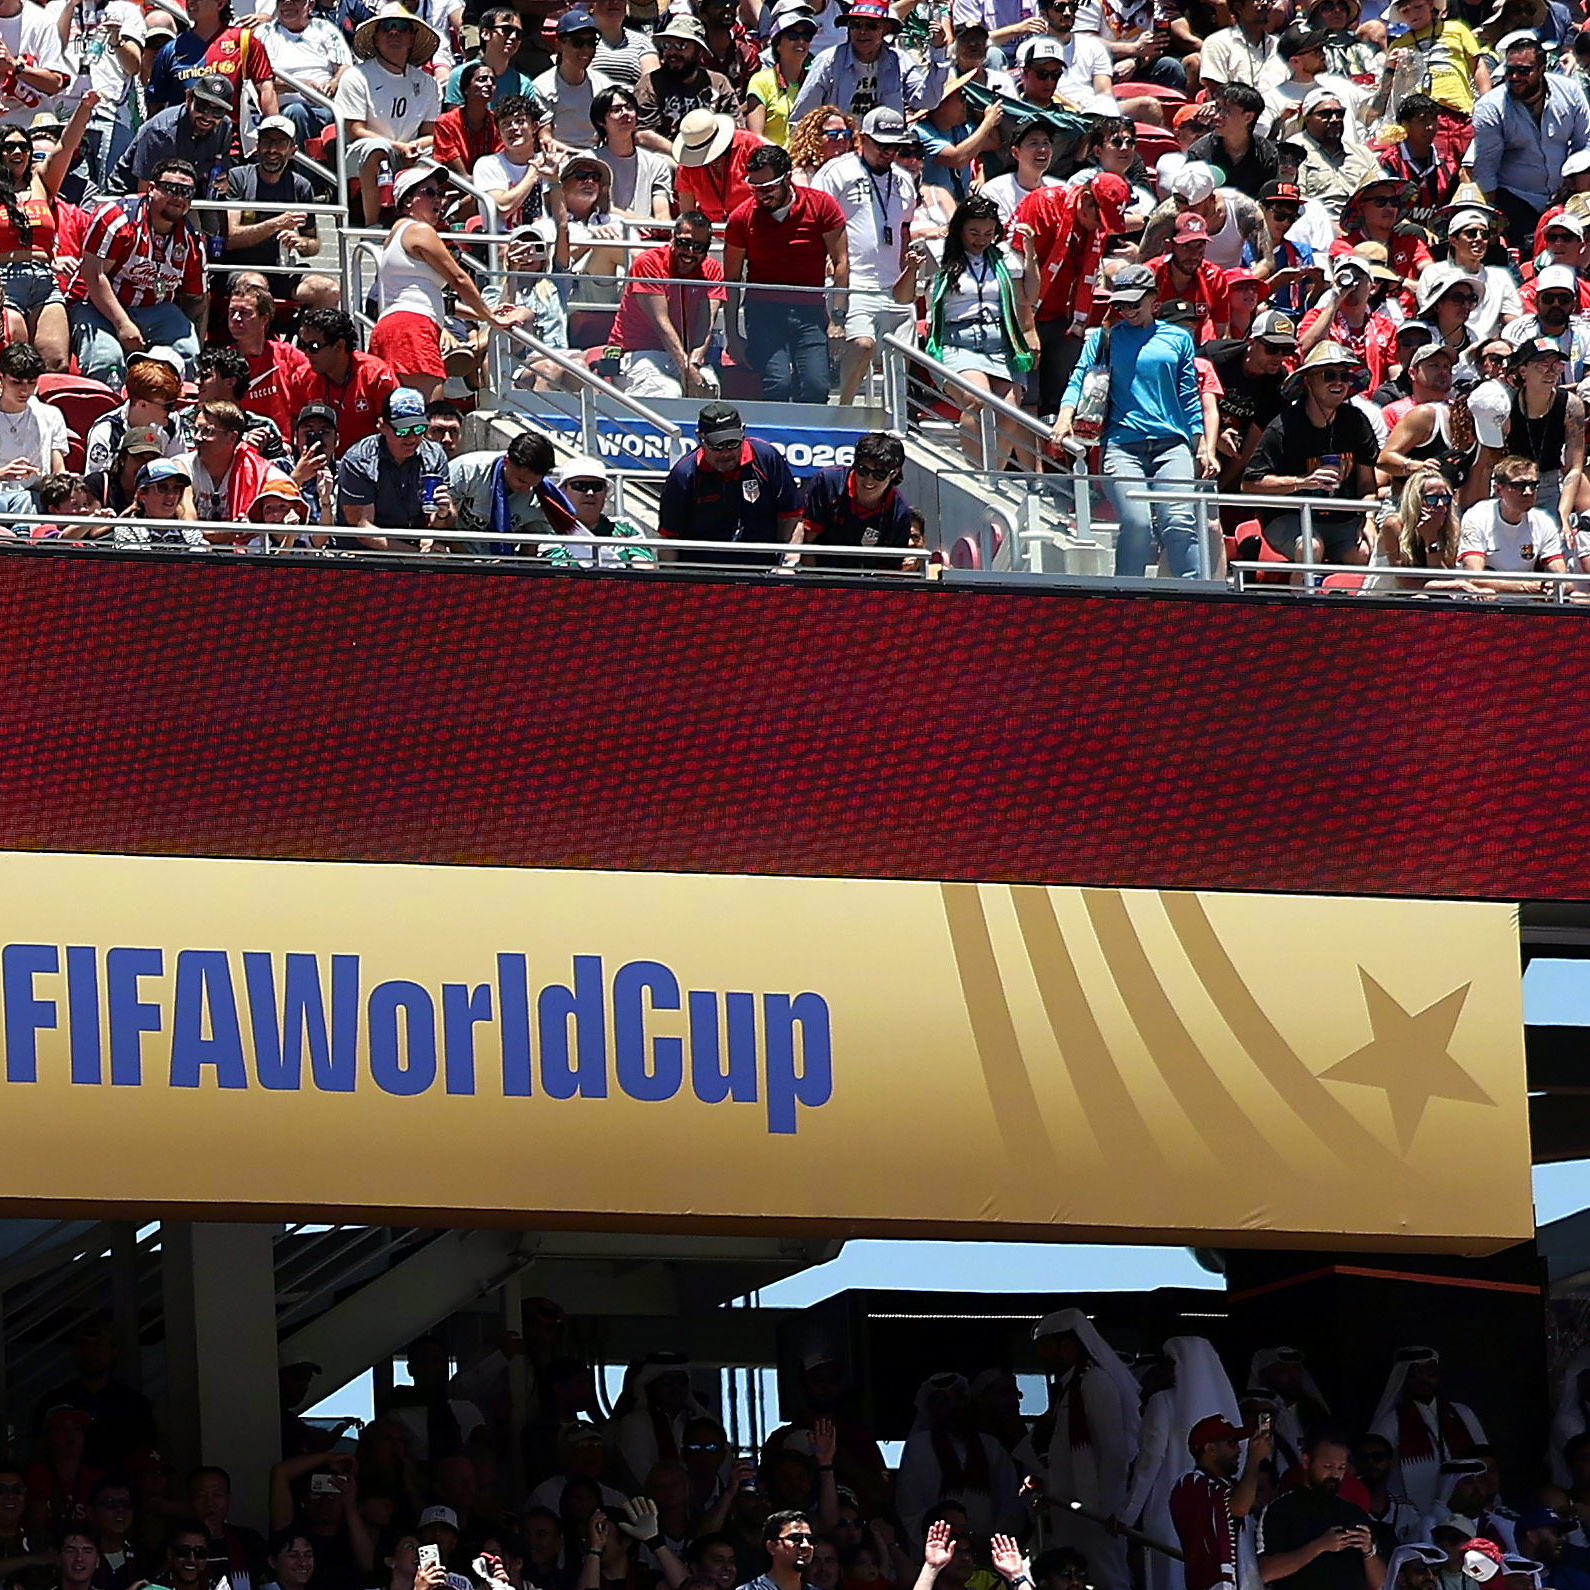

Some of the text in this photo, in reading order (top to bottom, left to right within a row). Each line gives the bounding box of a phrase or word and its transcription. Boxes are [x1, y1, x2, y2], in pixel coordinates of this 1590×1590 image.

[178, 62, 218, 81] unicef
[391, 96, 407, 118] 10
[249, 385, 278, 400] SOCCER
[596, 433, 670, 458] WOR
[783, 446, 855, 467] 026
